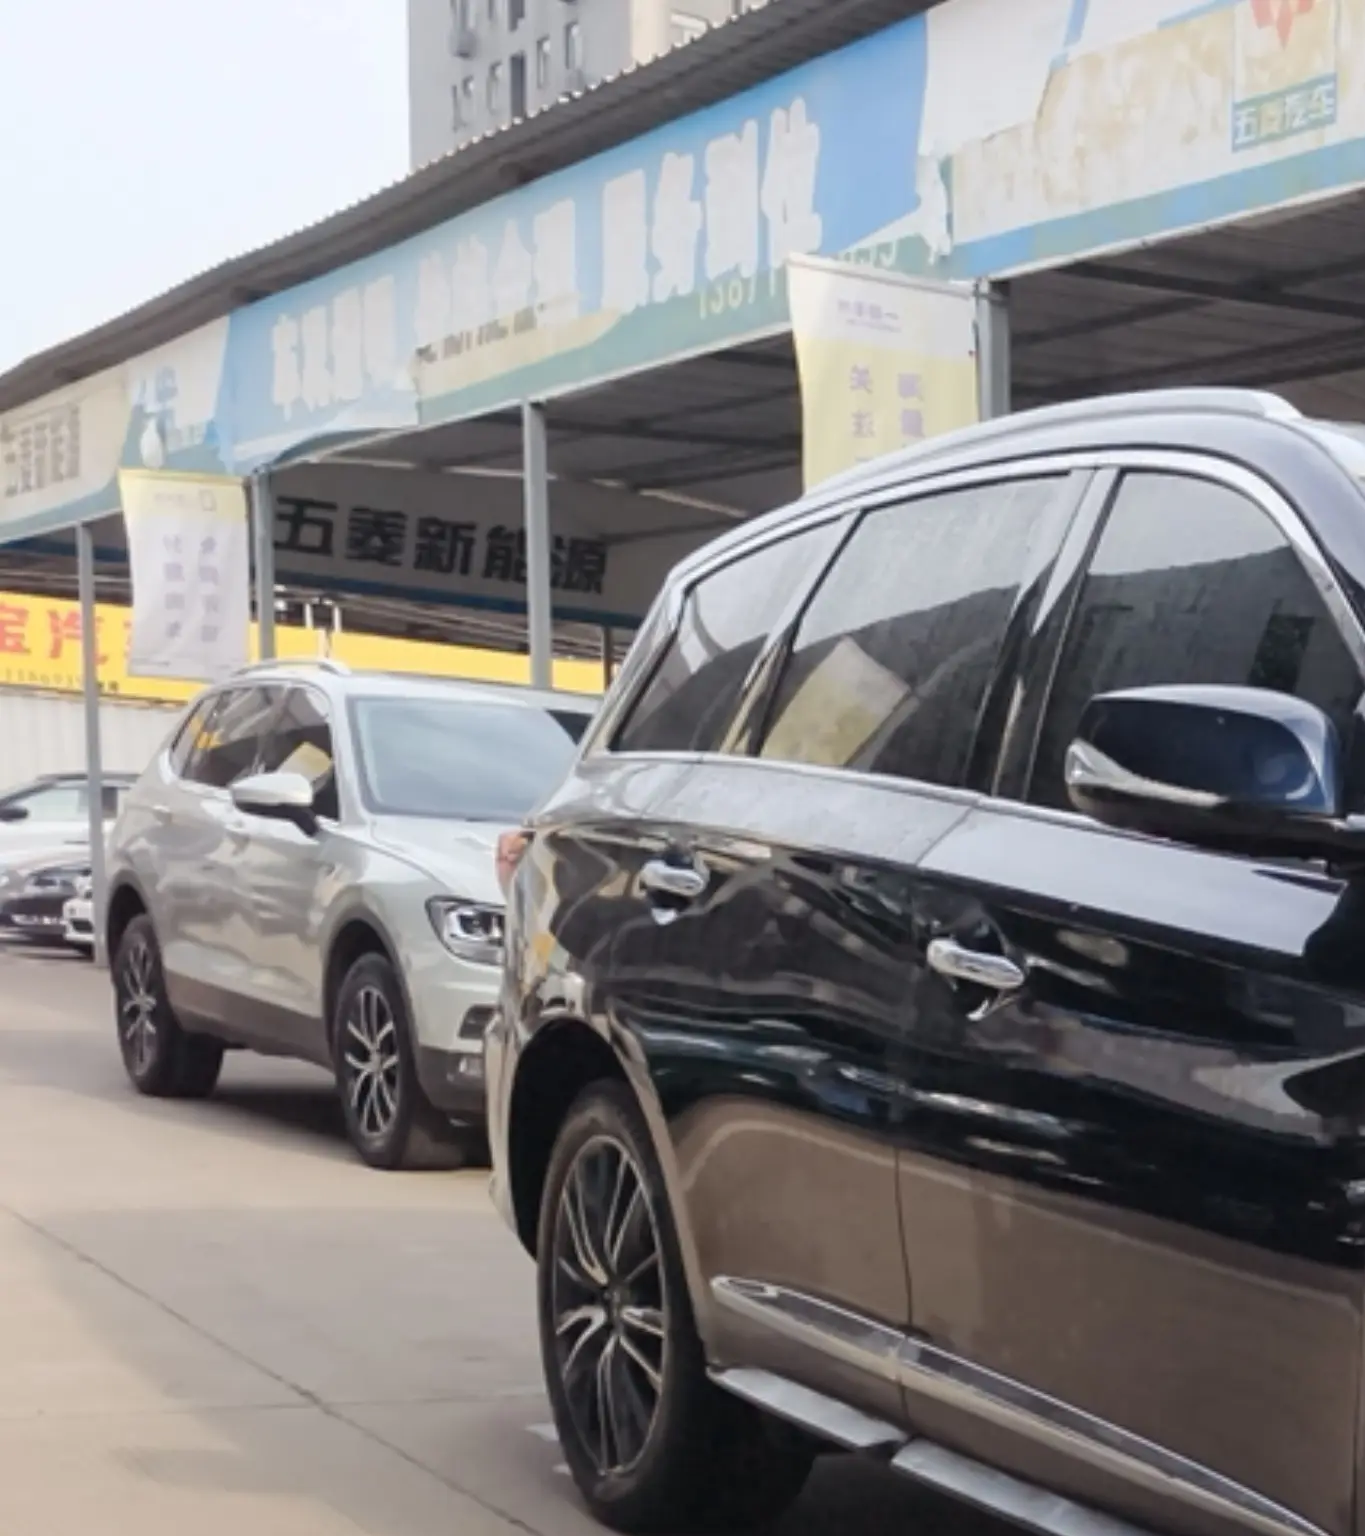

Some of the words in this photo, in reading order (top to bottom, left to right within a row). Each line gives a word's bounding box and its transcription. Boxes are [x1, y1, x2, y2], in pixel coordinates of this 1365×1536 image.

[274, 495, 606, 596] 五菱新能源
